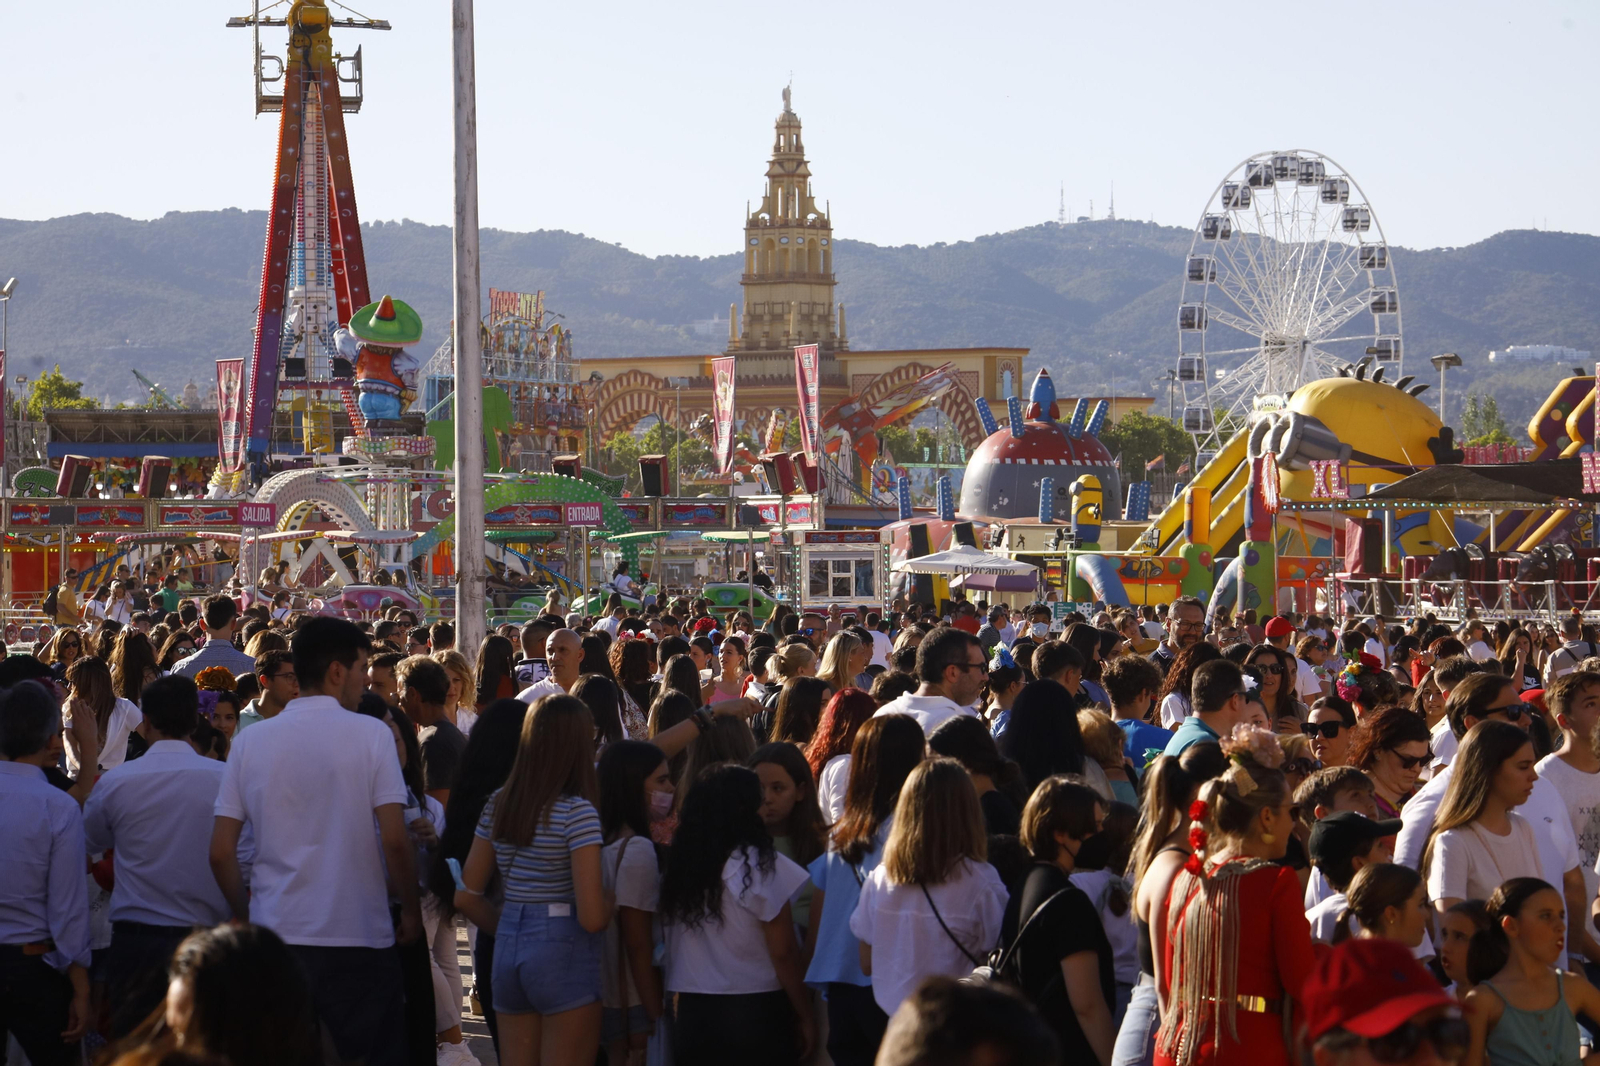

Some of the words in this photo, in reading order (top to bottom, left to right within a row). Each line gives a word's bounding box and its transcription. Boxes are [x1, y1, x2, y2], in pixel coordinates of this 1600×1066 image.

[1309, 460, 1349, 498] XL
[242, 506, 271, 522] SALIDA
[568, 507, 600, 522] ENTRADA
[954, 564, 1015, 576] Cruzcampo
